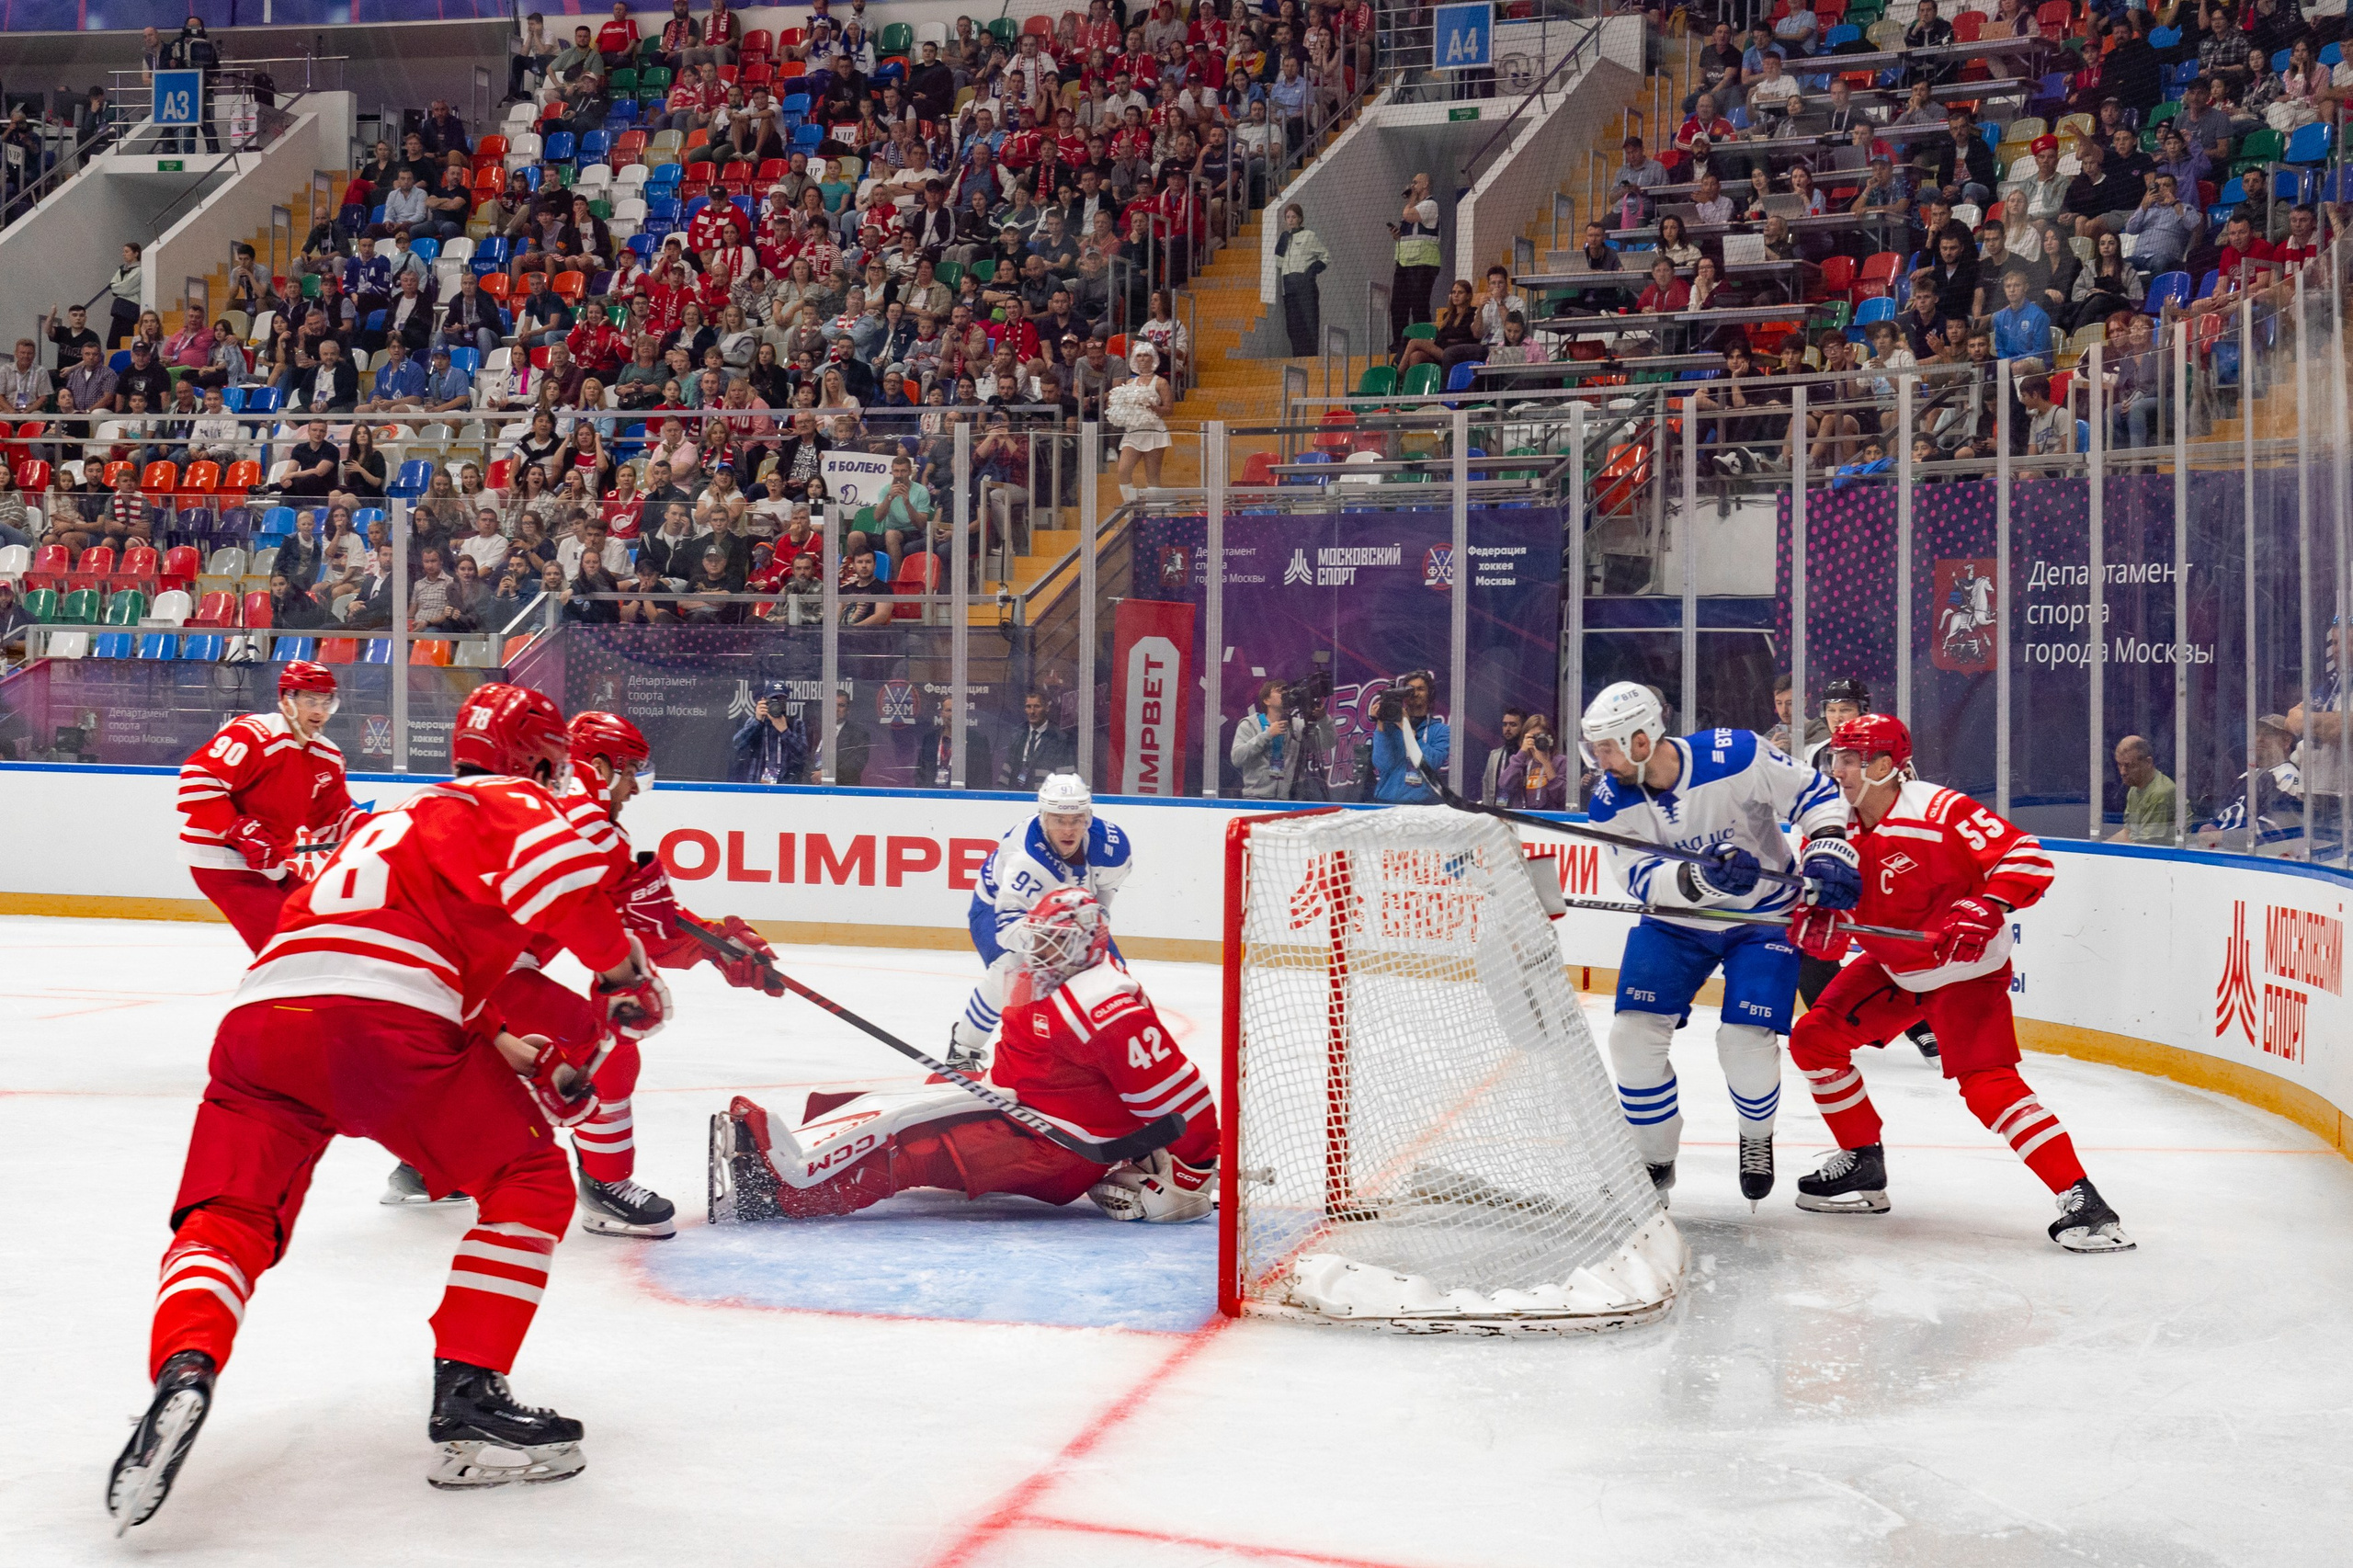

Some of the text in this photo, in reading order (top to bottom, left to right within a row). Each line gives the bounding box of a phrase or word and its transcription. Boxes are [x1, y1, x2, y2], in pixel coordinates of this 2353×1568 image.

[1446, 28, 1479, 62] A4
[162, 90, 190, 120] A3
[835, 131, 855, 142] VIP
[827, 460, 887, 474] Я БОЛЕЮ
[1196, 547, 1256, 558] Детамент
[1317, 543, 1402, 566] МОСКОВСКИЙ
[1467, 545, 1527, 557] Федерация
[1478, 562, 1514, 571] хоккея
[1229, 574, 1266, 583] Москвы
[1317, 567, 1358, 585] СПОРТ
[1475, 575, 1517, 586] Москвы
[2027, 561, 2194, 591] Депатамент
[628, 675, 697, 687] Департамент
[628, 691, 664, 702] спорта
[1620, 689, 1640, 701] ВТБ
[108, 708, 169, 720] Департамент
[628, 705, 707, 717] города Москвы
[882, 703, 914, 715] ФХМ
[467, 705, 494, 730] 78
[1138, 653, 1165, 794] IMPBET
[108, 722, 141, 731] спорта
[108, 733, 178, 744] города Москвы
[364, 735, 392, 747] ФХМ
[412, 734, 445, 744] хоккея
[208, 735, 249, 767] 90
[409, 746, 447, 757] Москвы
[1061, 786, 1074, 795] 97
[1104, 821, 1120, 845] ВТБ
[1955, 807, 2005, 851] 55
[309, 811, 415, 915] 8
[658, 828, 1002, 891] OLIMPB
[1011, 870, 1043, 898] 97
[1950, 899, 1989, 917] UER
[1764, 942, 1794, 955] CCM
[2265, 903, 2344, 998] МОСКОВСКИЙ
[1633, 989, 1656, 1003] ВТБ
[1749, 1004, 1773, 1018] ВТБ
[2263, 983, 2308, 1065] СПОРТ
[1128, 1026, 1172, 1070] 42
[915, 1054, 1054, 1136] WARRIOR
[807, 1133, 877, 1177] CCM
[1176, 1171, 1202, 1185] CCM
